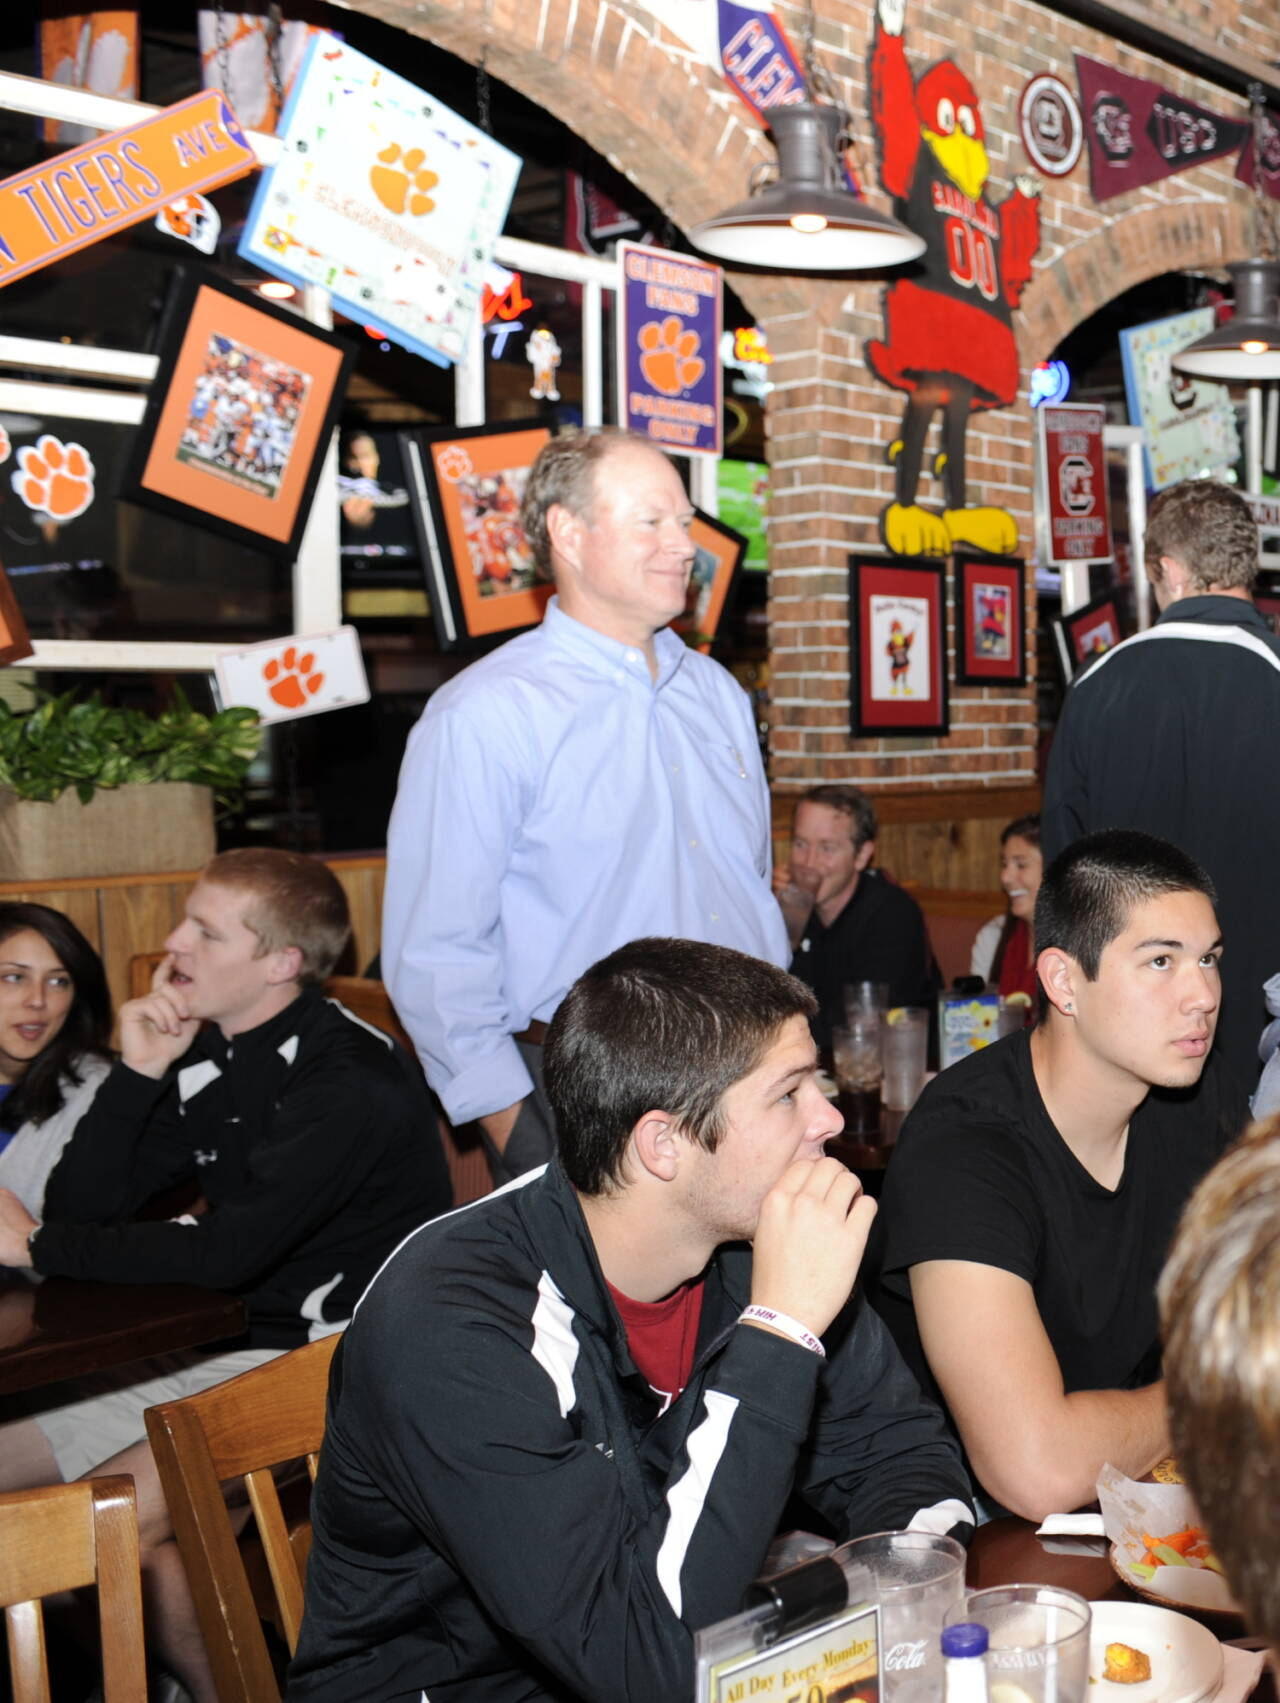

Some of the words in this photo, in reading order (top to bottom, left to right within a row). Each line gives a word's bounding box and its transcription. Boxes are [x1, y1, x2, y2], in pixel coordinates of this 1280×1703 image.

[17, 140, 162, 243] TIGERS
[172, 120, 228, 168] AVE
[626, 252, 717, 298] CLEMSON
[944, 216, 999, 302] 00
[645, 284, 700, 317] FANS
[629, 392, 716, 427] PARKING
[648, 417, 700, 445] ONLY
[726, 1680, 745, 1703] All
[750, 1673, 777, 1696] Day
[783, 1663, 819, 1689] Every
[822, 1638, 872, 1671] Monday
[884, 1638, 929, 1672] Cola
